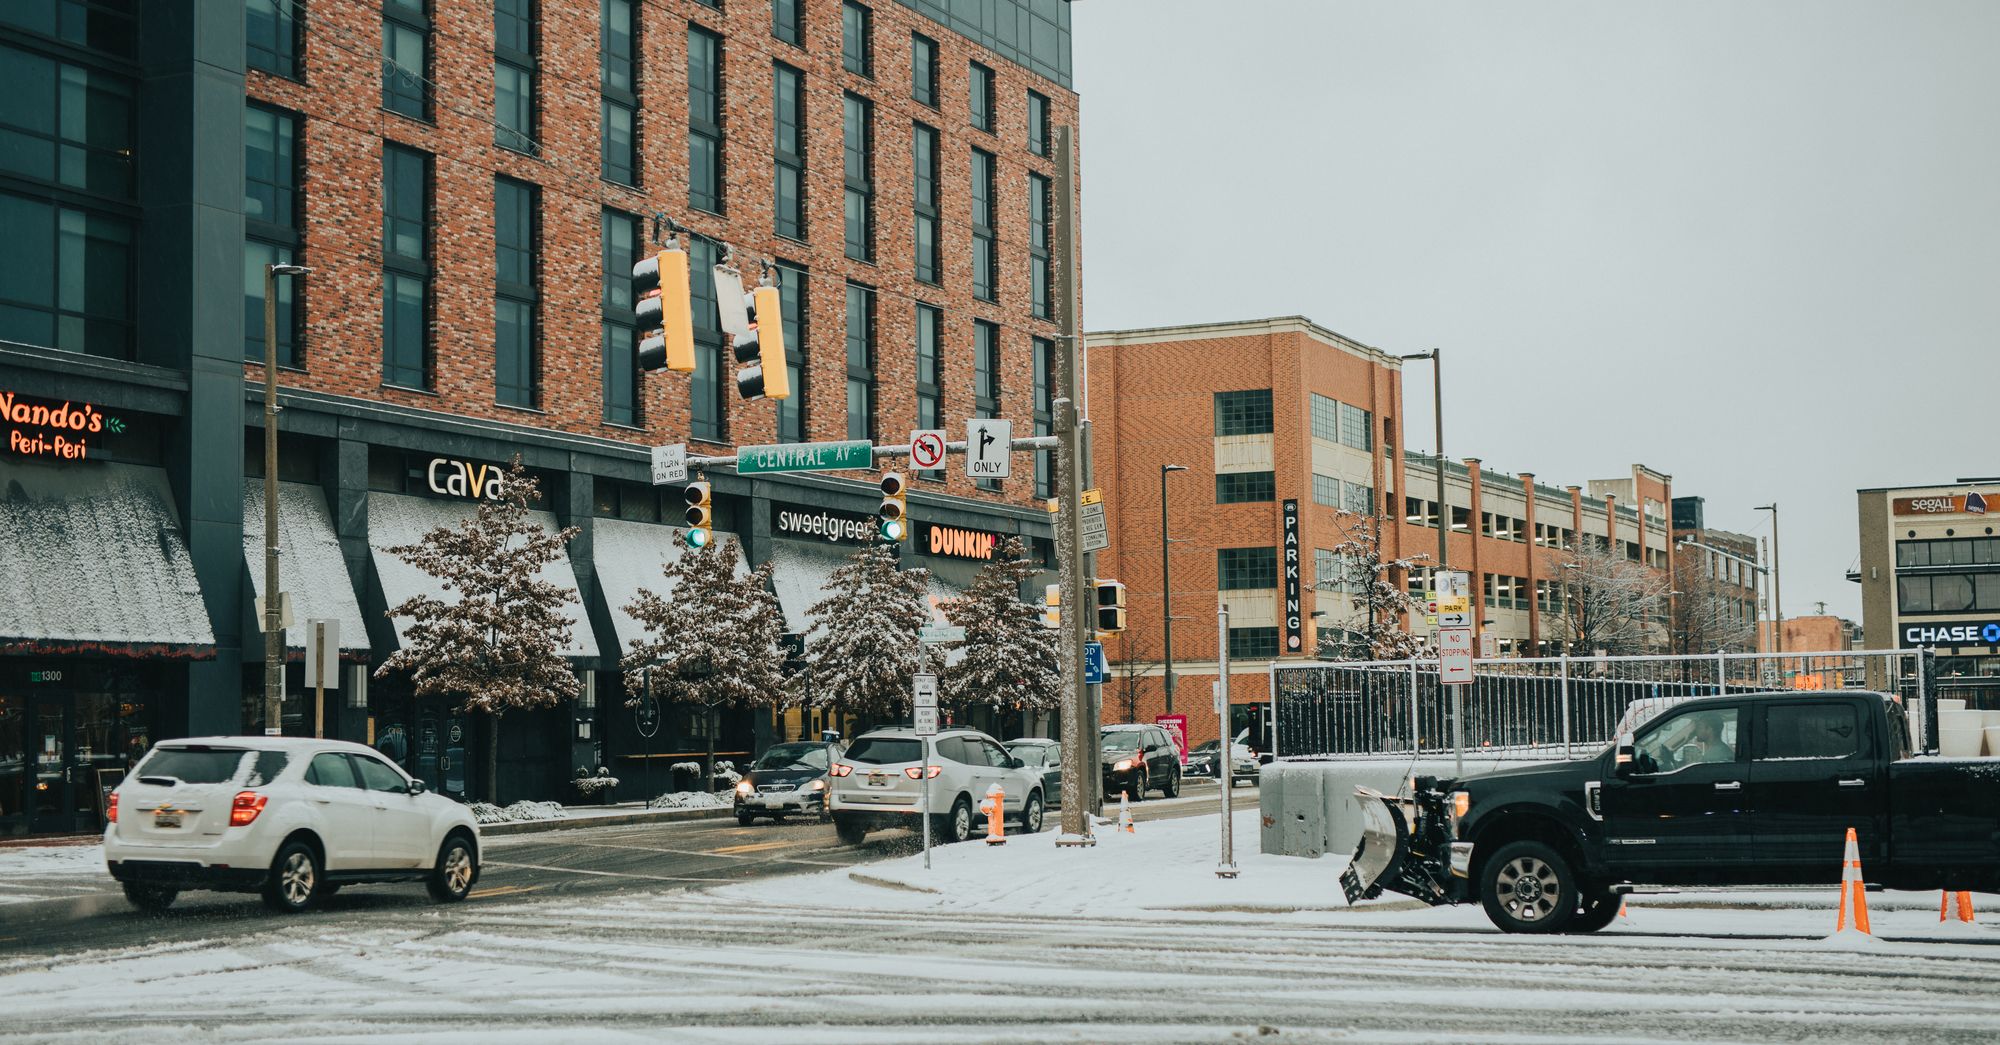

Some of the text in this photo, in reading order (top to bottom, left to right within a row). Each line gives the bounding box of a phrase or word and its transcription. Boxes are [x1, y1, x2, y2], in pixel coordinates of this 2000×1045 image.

[0, 392, 103, 433] Nando's
[11, 430, 86, 460] Peri-Peri
[663, 449, 675, 457] NO
[758, 445, 850, 468] CENTRAL AV
[660, 460, 679, 469] TURN
[974, 462, 1001, 473] ONLY
[670, 470, 684, 478] RED
[779, 511, 870, 542] sweetgree
[931, 525, 995, 560] DUNKIN'
[1285, 516, 1300, 629] PARKING
[1450, 634, 1460, 643] NO
[1906, 625, 1980, 643] CHASE
[786, 644, 798, 653] sg
[1441, 648, 1470, 657] STOPPING
[41, 670, 62, 681] 1300
